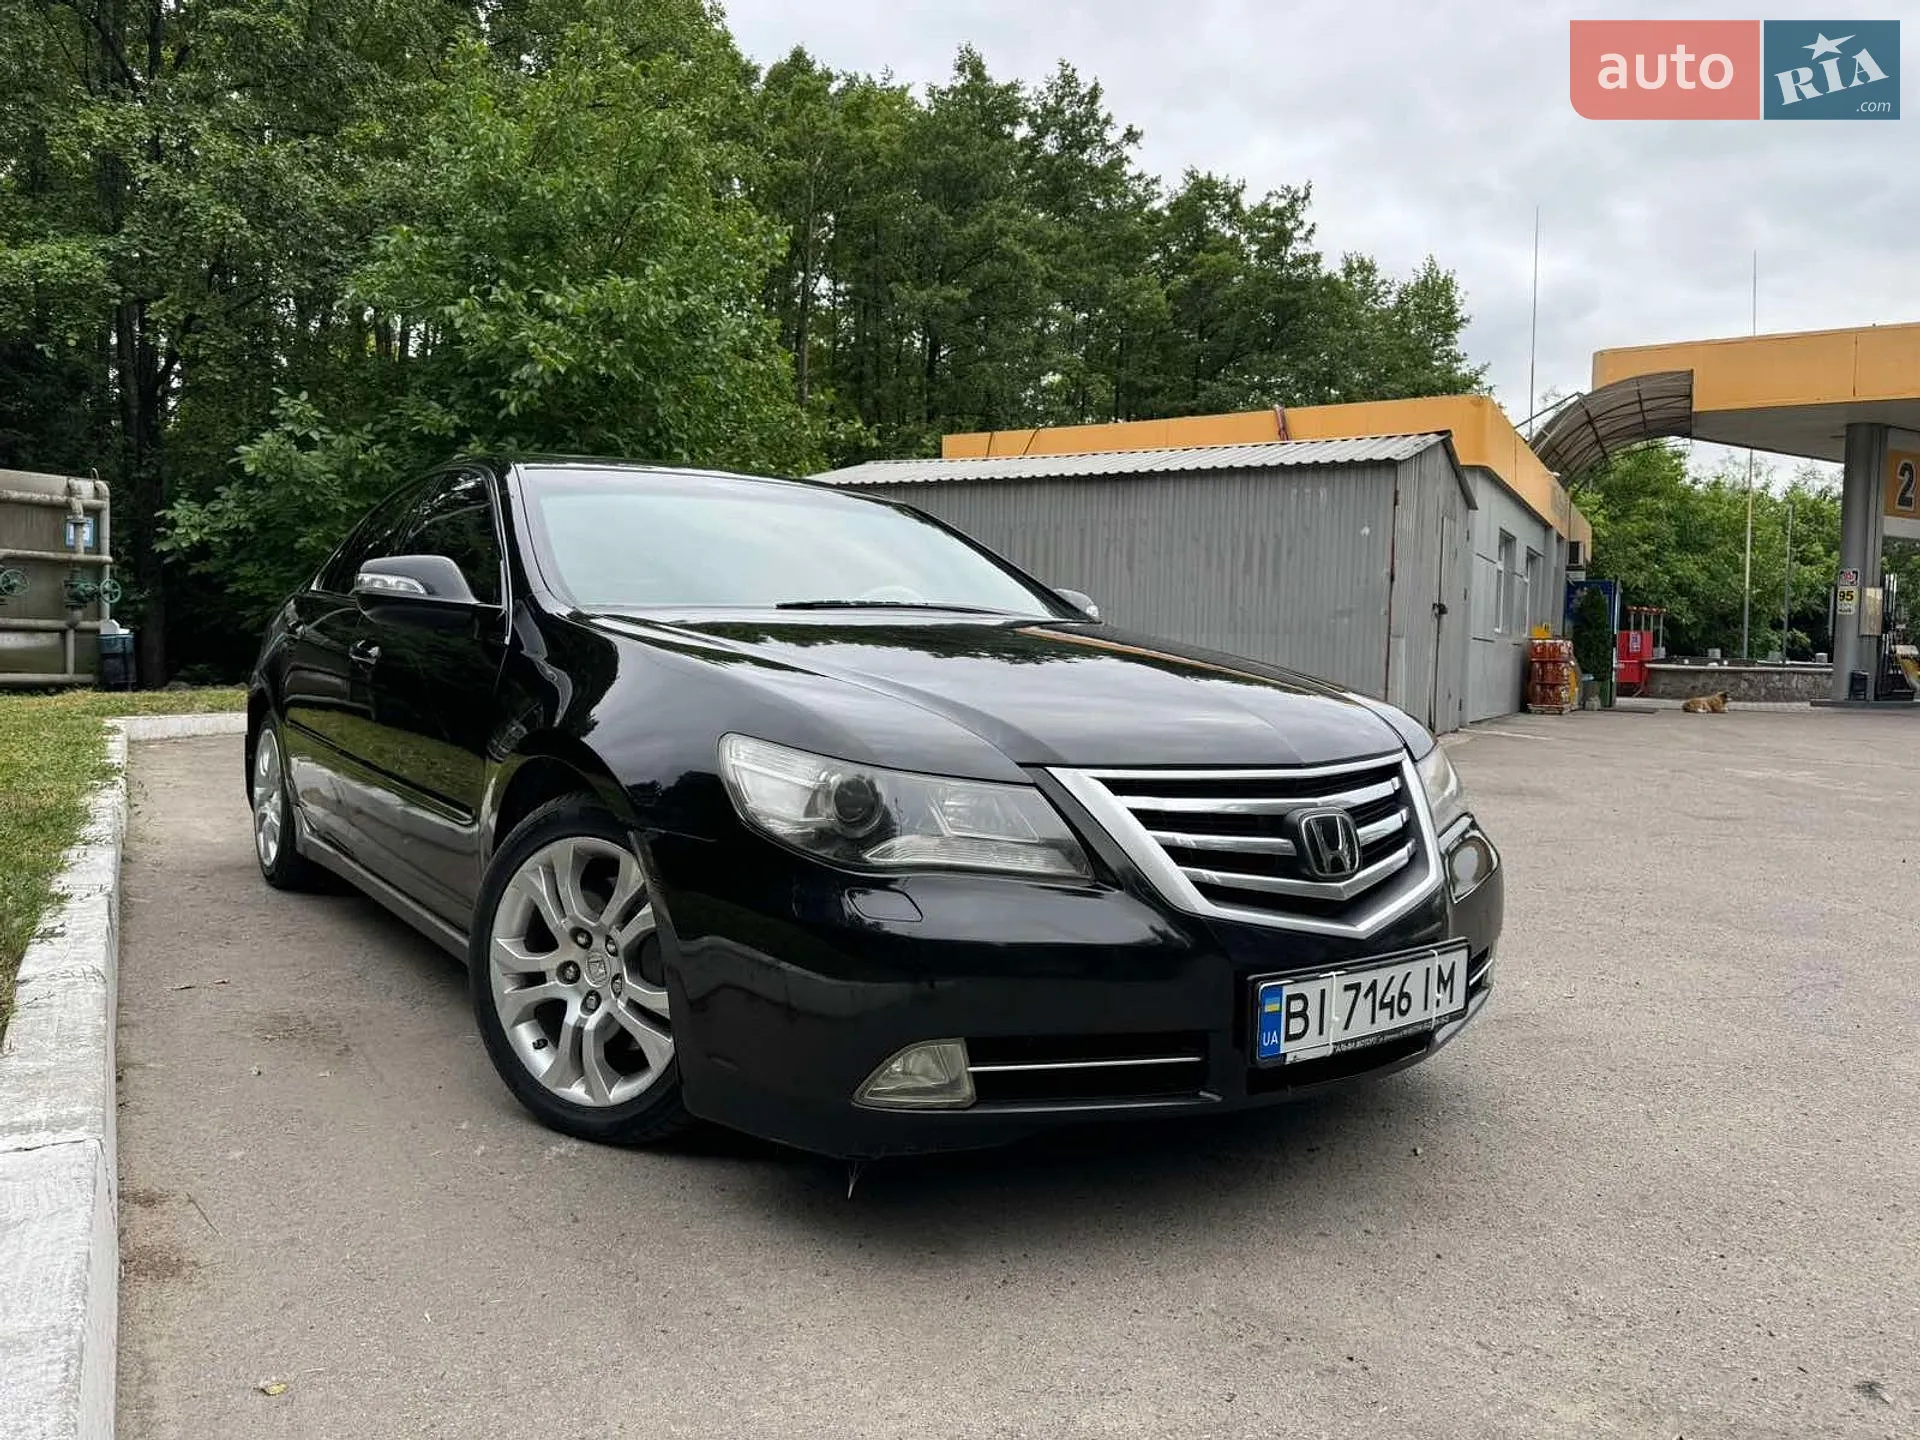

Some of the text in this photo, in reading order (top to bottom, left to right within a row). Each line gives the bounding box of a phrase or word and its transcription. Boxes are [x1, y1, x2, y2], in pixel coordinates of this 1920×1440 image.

[1896, 459, 1917, 513] 2
[1839, 590, 1854, 602] 95
[1284, 988, 1327, 1043] BI
[1342, 970, 1413, 1031] 7146
[1262, 1030, 1279, 1047] UA
